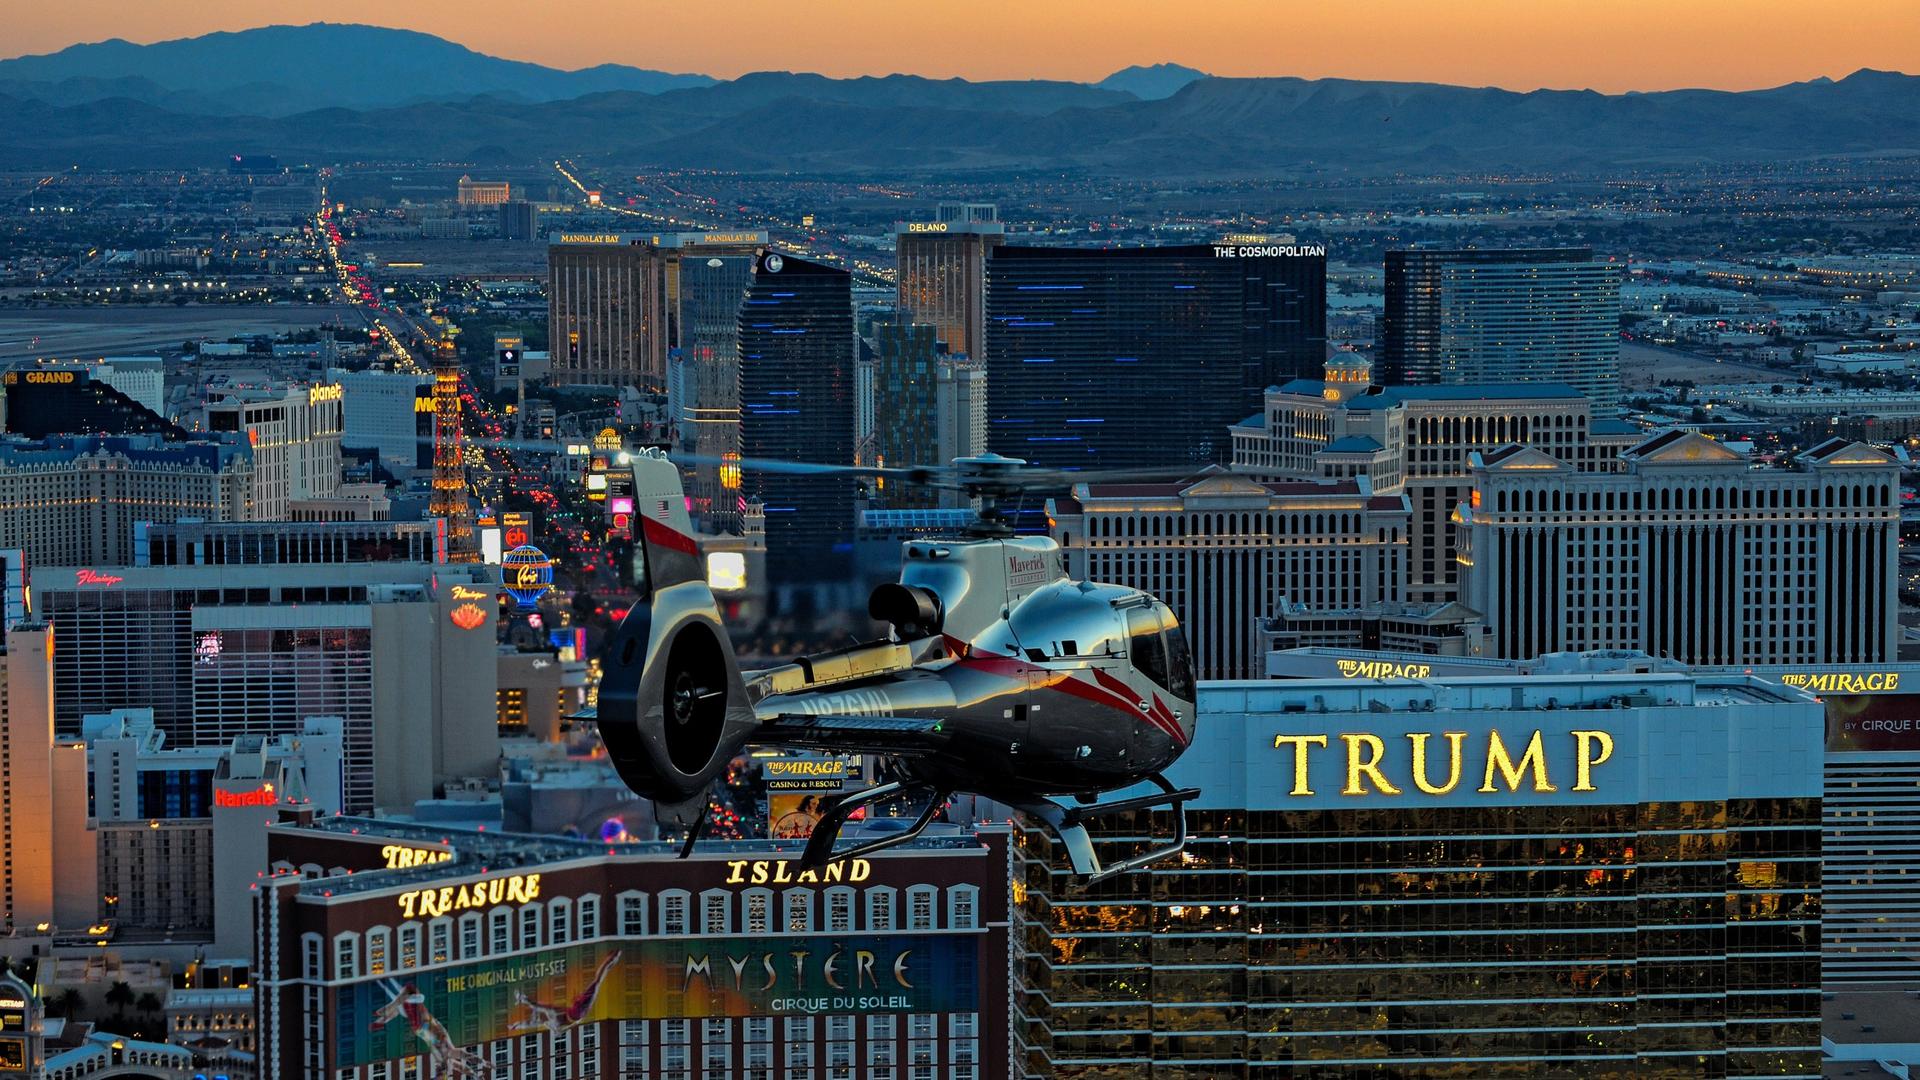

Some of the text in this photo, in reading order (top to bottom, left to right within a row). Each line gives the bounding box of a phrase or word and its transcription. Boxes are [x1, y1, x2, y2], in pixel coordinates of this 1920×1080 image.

[909, 223, 947, 232] DELANO
[561, 235, 619, 243] MANDALAY BAY
[705, 234, 744, 242] MANDALAY
[1214, 246, 1325, 257] THE COSMOPOLITAN
[26, 372, 74, 383] GRAND
[310, 382, 342, 407] planet
[1009, 553, 1045, 573] Maverick
[76, 569, 123, 587] Flamingo
[518, 565, 538, 588] Paris
[1337, 660, 1430, 679] THE MIRAGE
[1782, 673, 1899, 693] THE MIRAGE
[1845, 722, 1856, 730] BY
[1862, 720, 1911, 733] CIRQUE
[767, 762, 784, 771] THE
[780, 761, 843, 776] MIRAGE
[1274, 728, 1615, 796] TRUMP
[726, 859, 871, 884] ISLAND
[398, 874, 541, 918] TREASURE
[446, 959, 566, 993] THE ORIGINAL MUST-SEE
[771, 996, 912, 1014] CIRQUE DU SOLEIL
